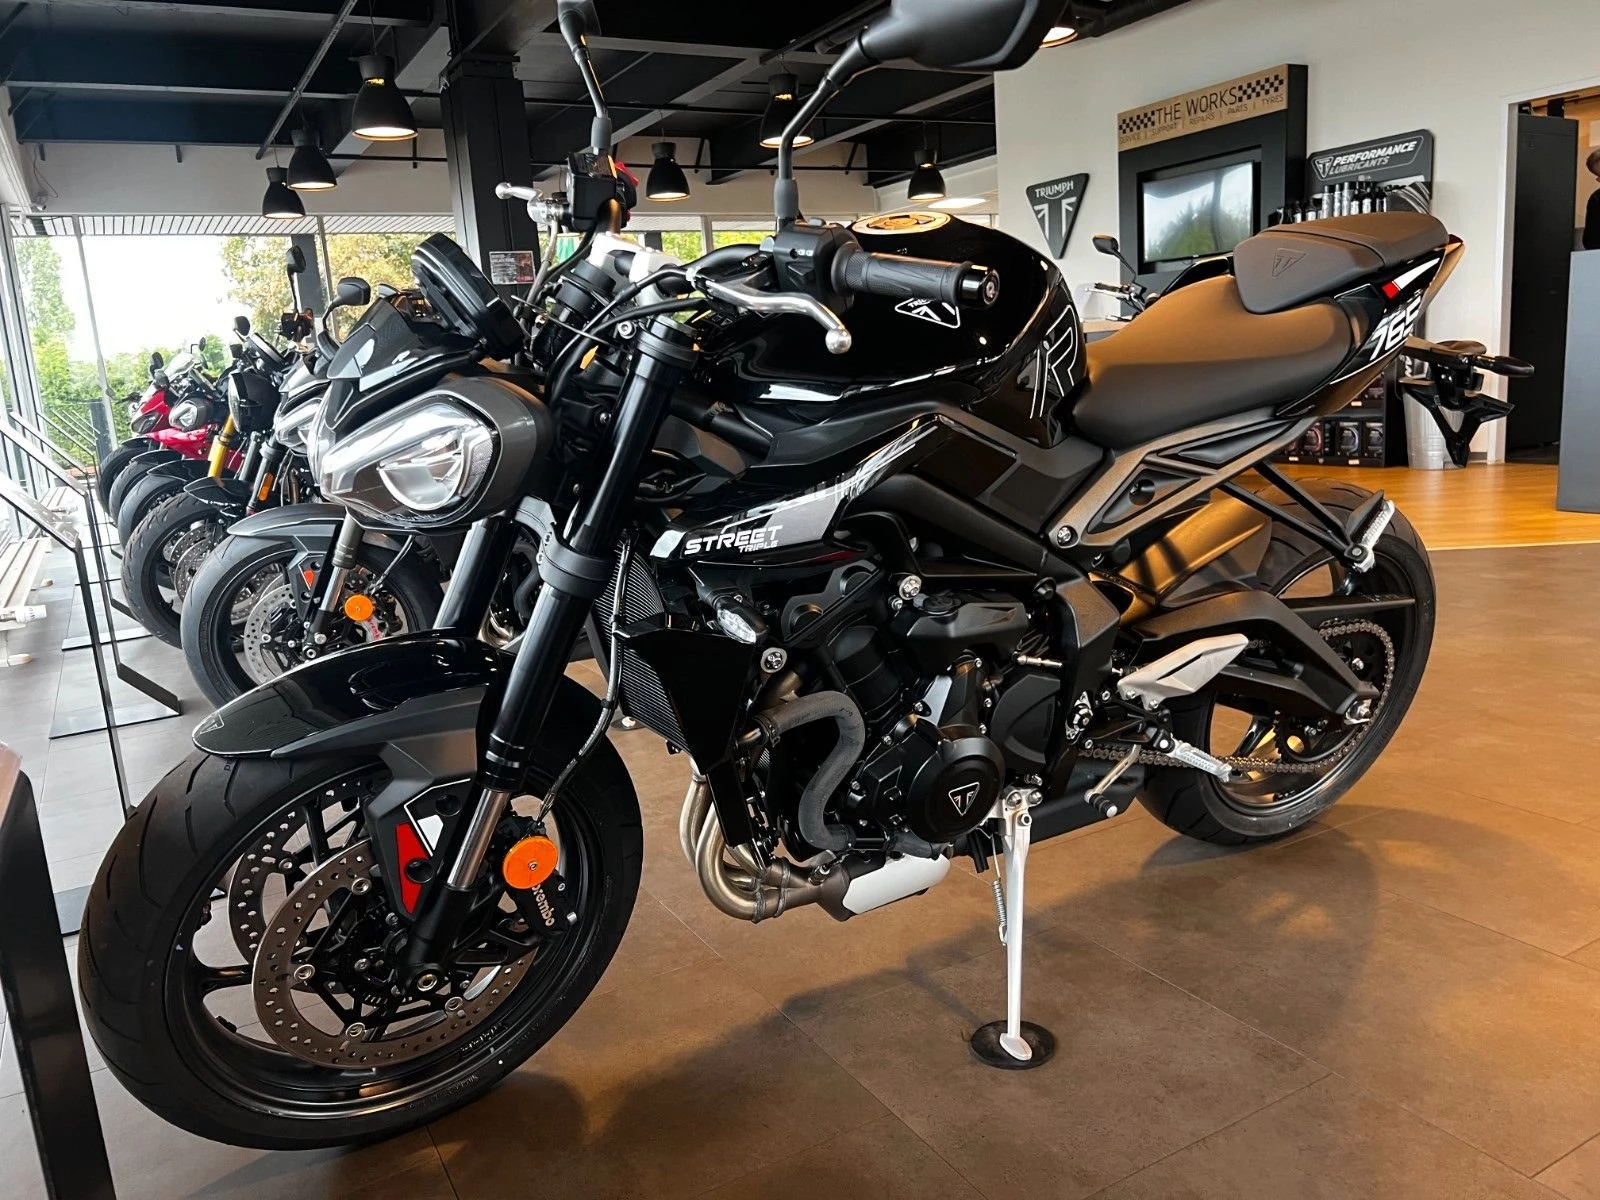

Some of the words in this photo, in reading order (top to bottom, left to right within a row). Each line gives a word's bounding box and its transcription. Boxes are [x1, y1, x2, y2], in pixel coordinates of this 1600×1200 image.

[1119, 131, 1142, 145] SERVICE
[1151, 122, 1178, 136] SUPPORT
[1189, 112, 1216, 125] REPAIRS
[1227, 103, 1248, 115] PARTS
[1261, 95, 1284, 107] TYRES
[1156, 102, 1182, 125] THE
[1186, 86, 1238, 117] WORKS
[1328, 155, 1391, 176] LUBRICANTS
[1332, 140, 1418, 167] PERFORMANCE
[1034, 180, 1074, 199] TRIUMPH
[1370, 295, 1421, 361] 765
[684, 524, 784, 556] STREET
[738, 539, 779, 554] TRIPLE
